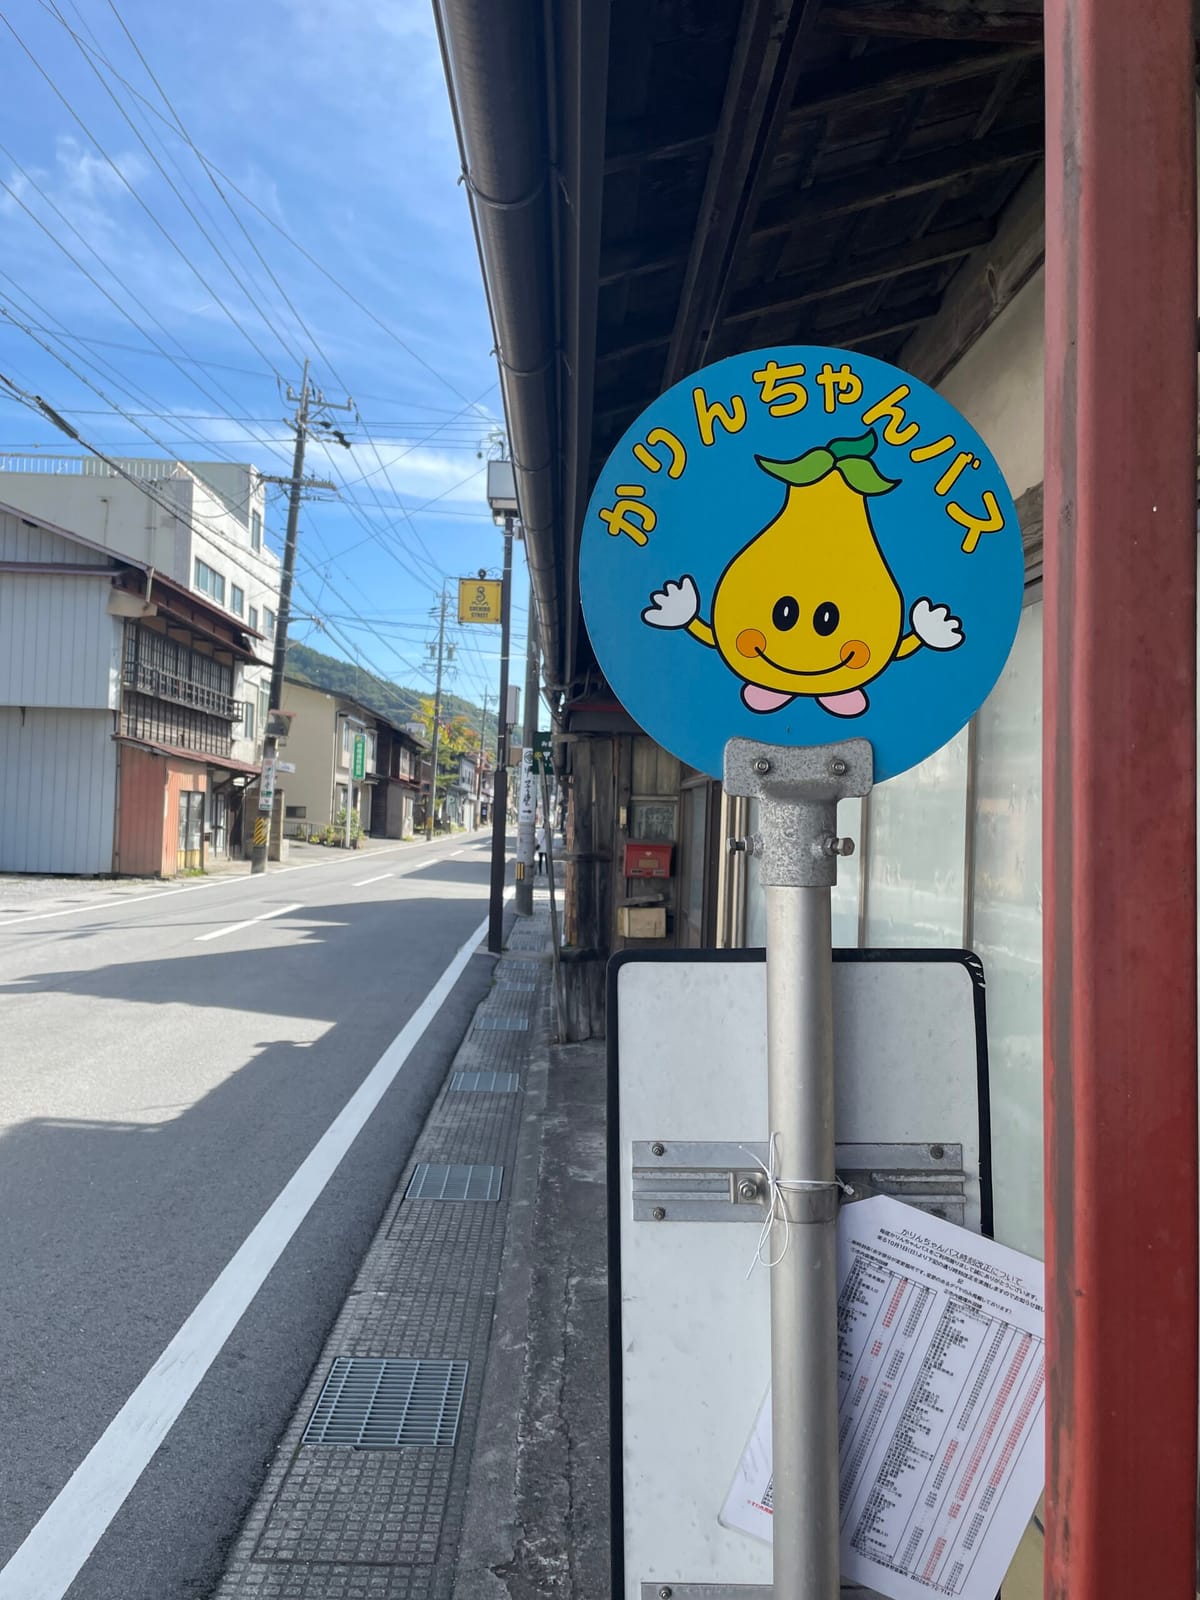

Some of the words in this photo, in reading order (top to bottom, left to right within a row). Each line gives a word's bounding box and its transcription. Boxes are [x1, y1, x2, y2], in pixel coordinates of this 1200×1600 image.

[599, 361, 1005, 554] かりんちゃんバス
